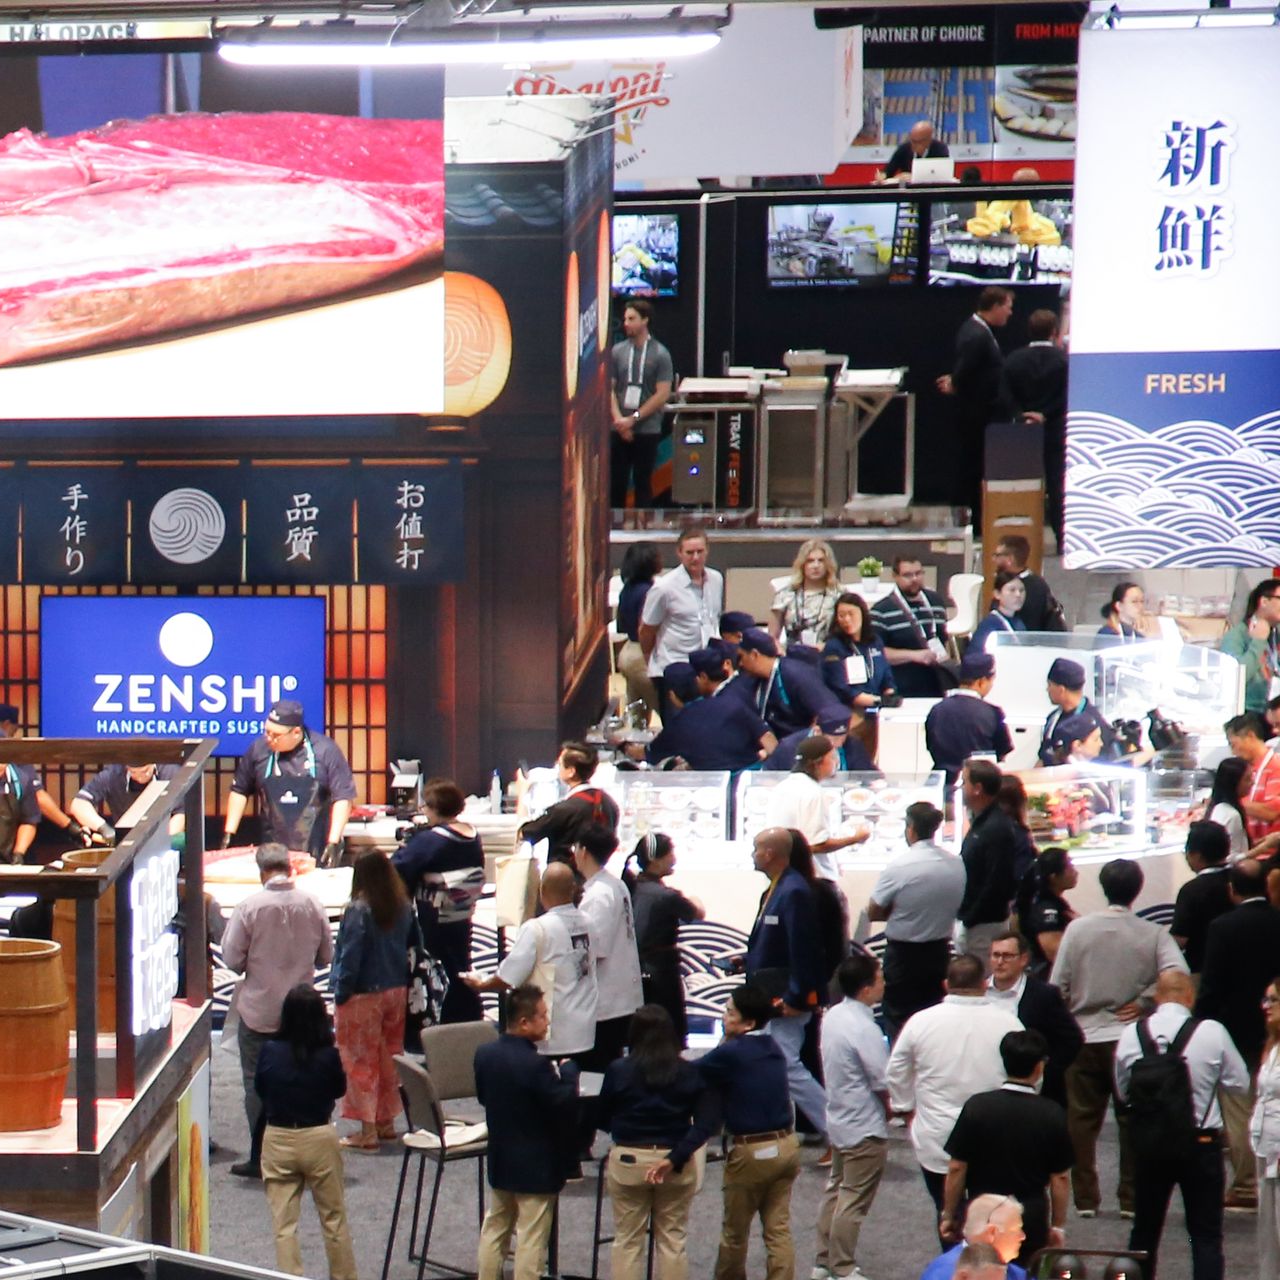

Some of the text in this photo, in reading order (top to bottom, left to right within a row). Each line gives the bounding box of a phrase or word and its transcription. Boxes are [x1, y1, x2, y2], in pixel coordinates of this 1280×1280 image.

[864, 24, 985, 43] PARTNER OF CHOICE
[1015, 22, 1051, 39] FROM
[1157, 119, 1233, 272] 新鮮
[1145, 373, 1226, 395] FRESH
[59, 483, 88, 575] 手作り
[284, 492, 320, 562] 品質
[395, 480, 425, 570] お値打
[96, 719, 220, 734] HANDCRAFTED
